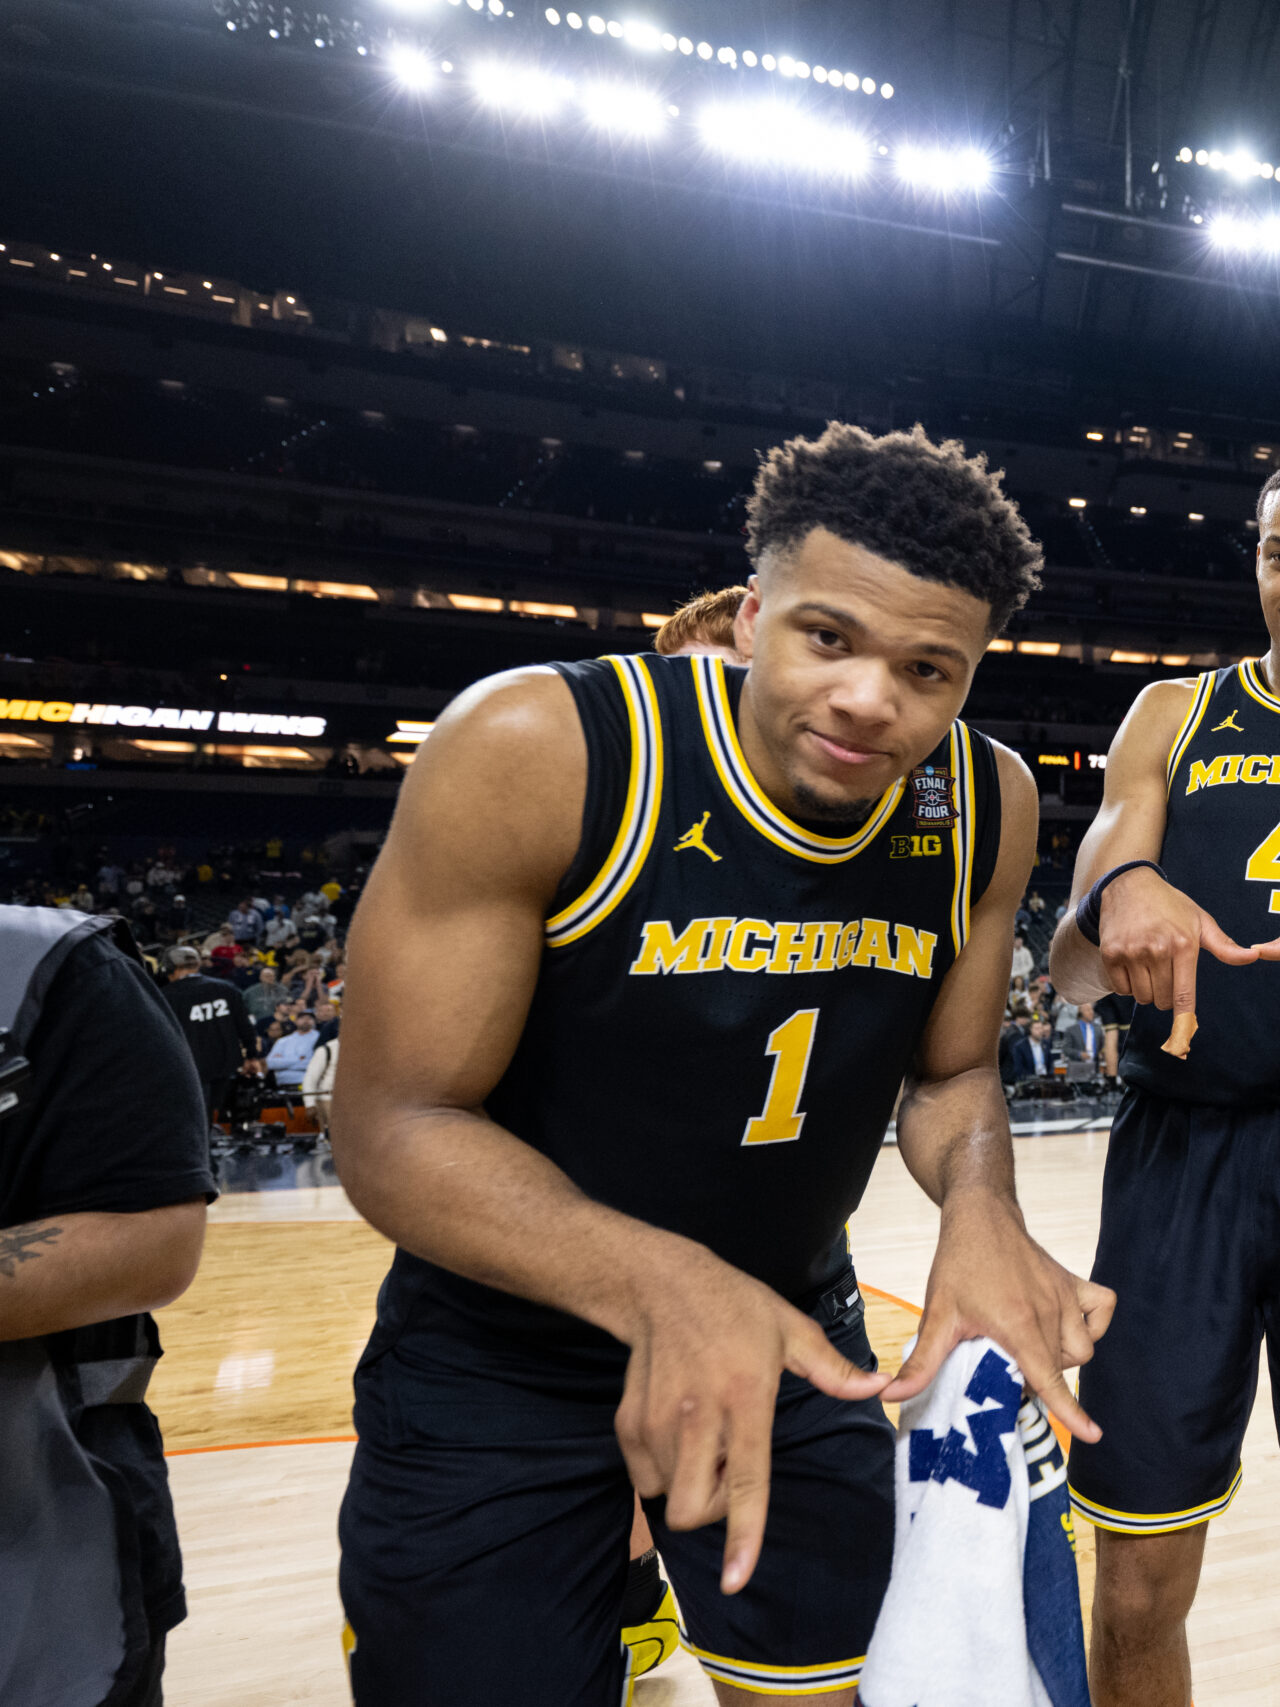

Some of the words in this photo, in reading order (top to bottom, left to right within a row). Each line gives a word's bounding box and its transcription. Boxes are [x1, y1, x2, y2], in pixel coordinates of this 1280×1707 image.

[217, 712, 327, 737] WINS
[914, 776, 947, 791] FINAL
[918, 804, 950, 819] FOUR
[629, 916, 938, 979] MICHIGAN
[190, 998, 230, 1022] 472
[740, 1008, 820, 1147] 1
